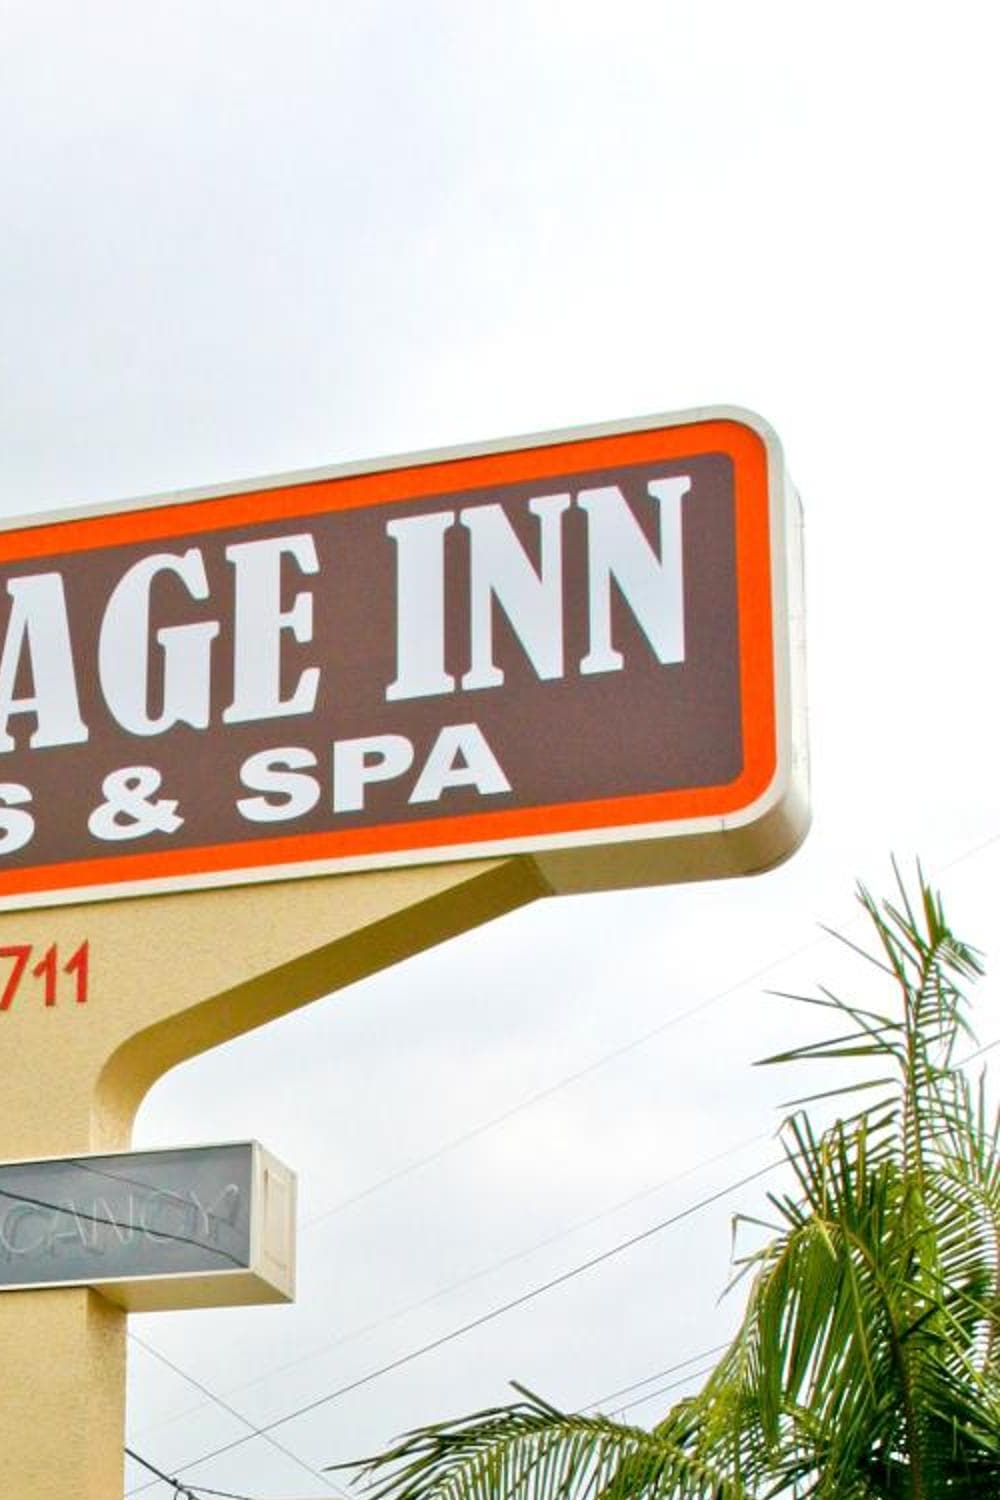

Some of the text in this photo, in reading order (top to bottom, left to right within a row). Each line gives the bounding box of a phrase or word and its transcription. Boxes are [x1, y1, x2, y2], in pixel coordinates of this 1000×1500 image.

[385, 475, 692, 702] INN
[87, 765, 185, 841] &
[236, 722, 513, 823] SPA
